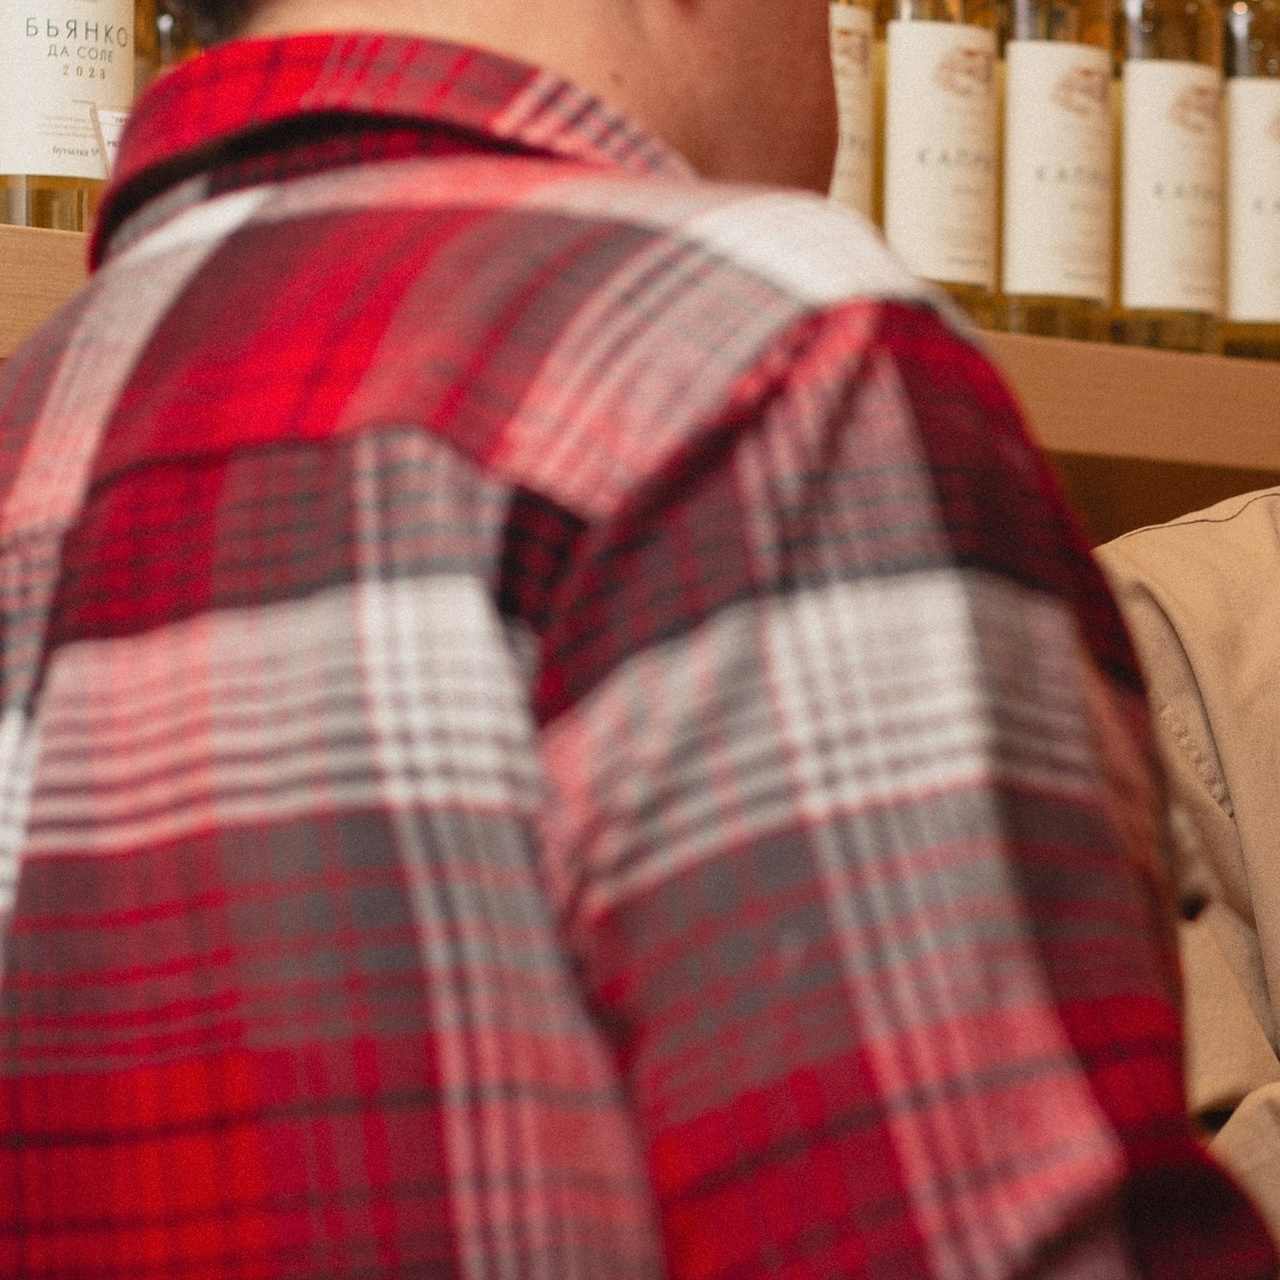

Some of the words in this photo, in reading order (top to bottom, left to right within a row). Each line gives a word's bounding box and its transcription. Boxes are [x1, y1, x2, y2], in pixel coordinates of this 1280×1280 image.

[25, 17, 128, 48] БЬЯНКО
[47, 44, 70, 58] ДА
[77, 46, 113, 63] СОЛЕ
